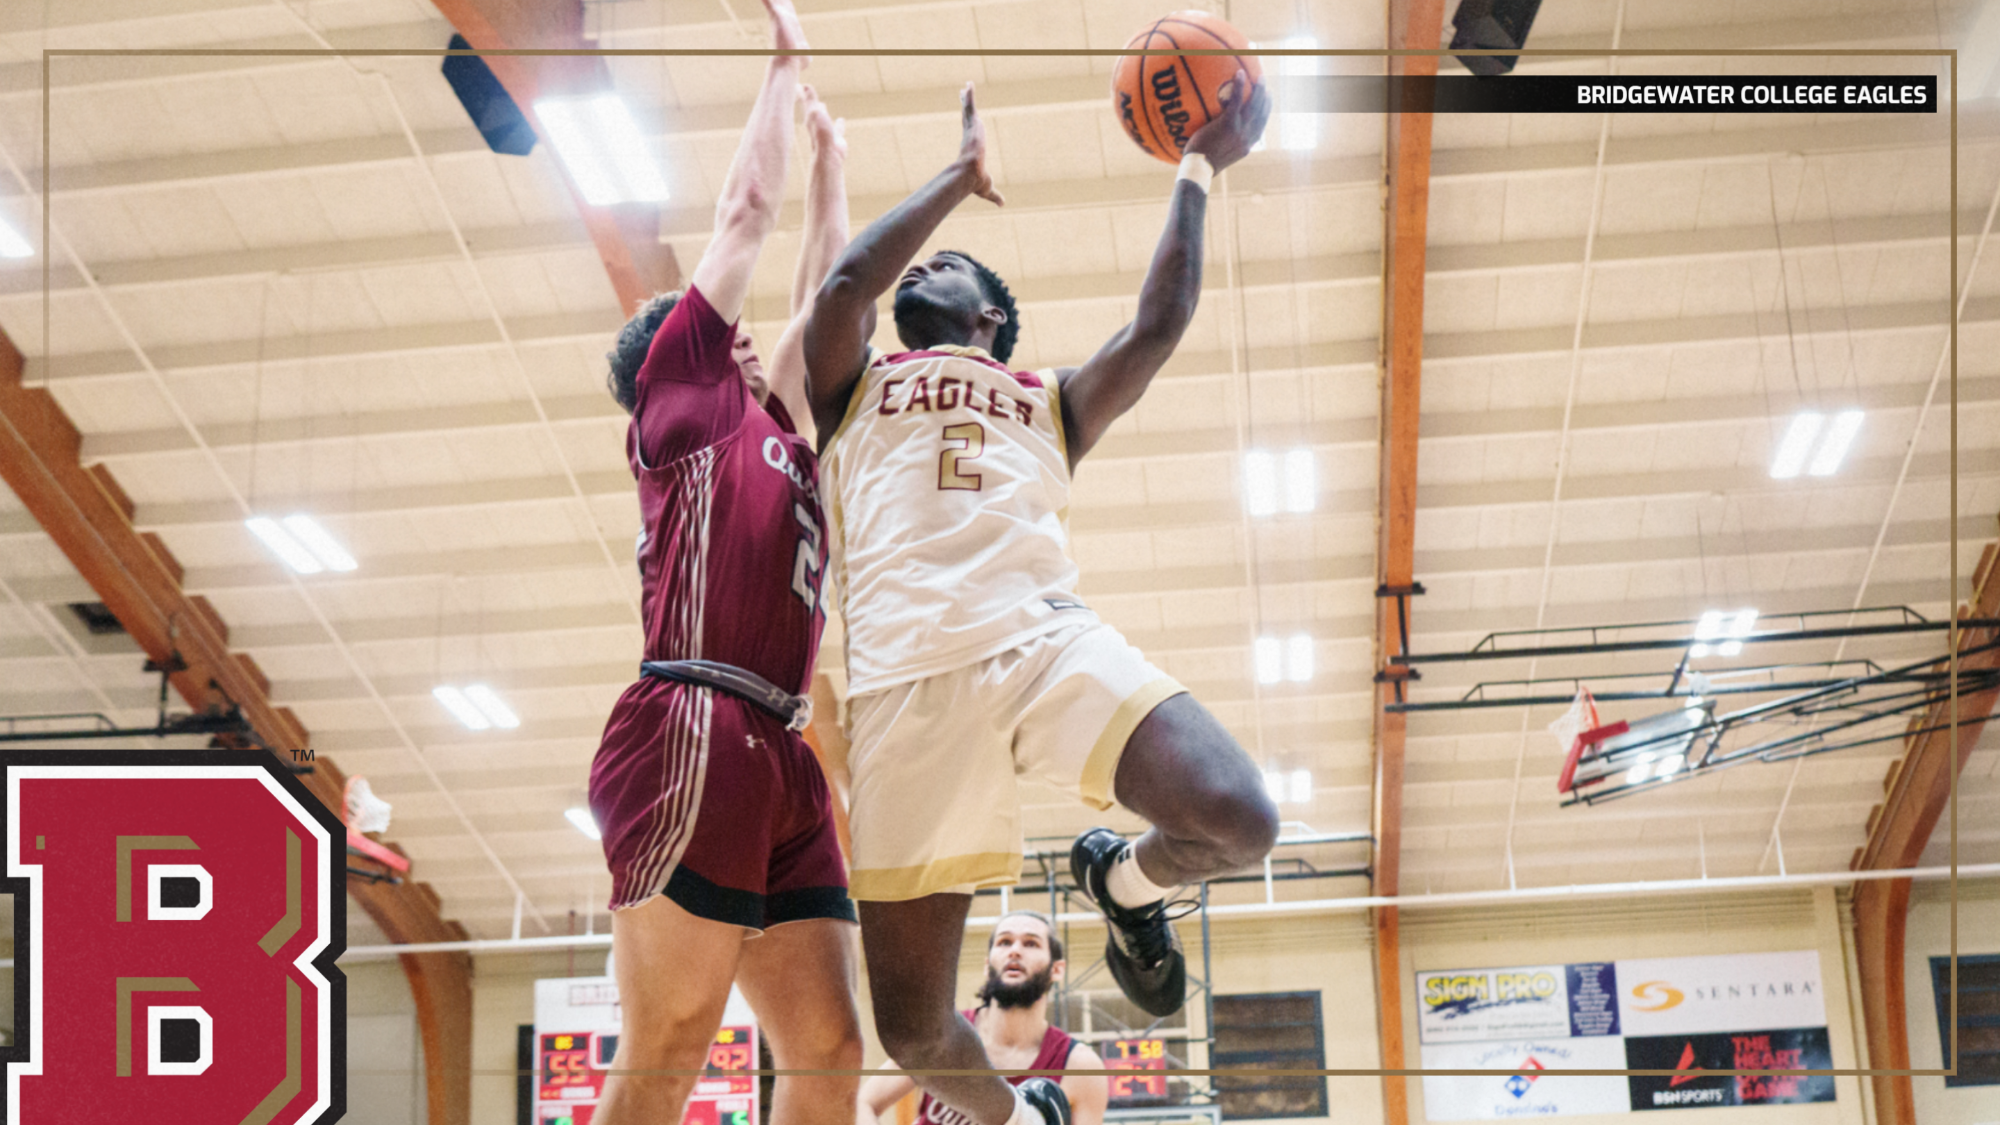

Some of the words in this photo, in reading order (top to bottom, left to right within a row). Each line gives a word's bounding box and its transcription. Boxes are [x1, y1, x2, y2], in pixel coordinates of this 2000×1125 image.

[1151, 64, 1190, 149] Wilso
[938, 421, 985, 491] 2
[791, 502, 829, 622] 2
[1424, 974, 1489, 1007] SIGN
[1495, 972, 1558, 1000] PRO
[1695, 980, 1813, 1000] SENTARA
[548, 1054, 586, 1085] 55
[710, 1048, 749, 1078] 92
[1114, 1062, 1156, 1096] 24
